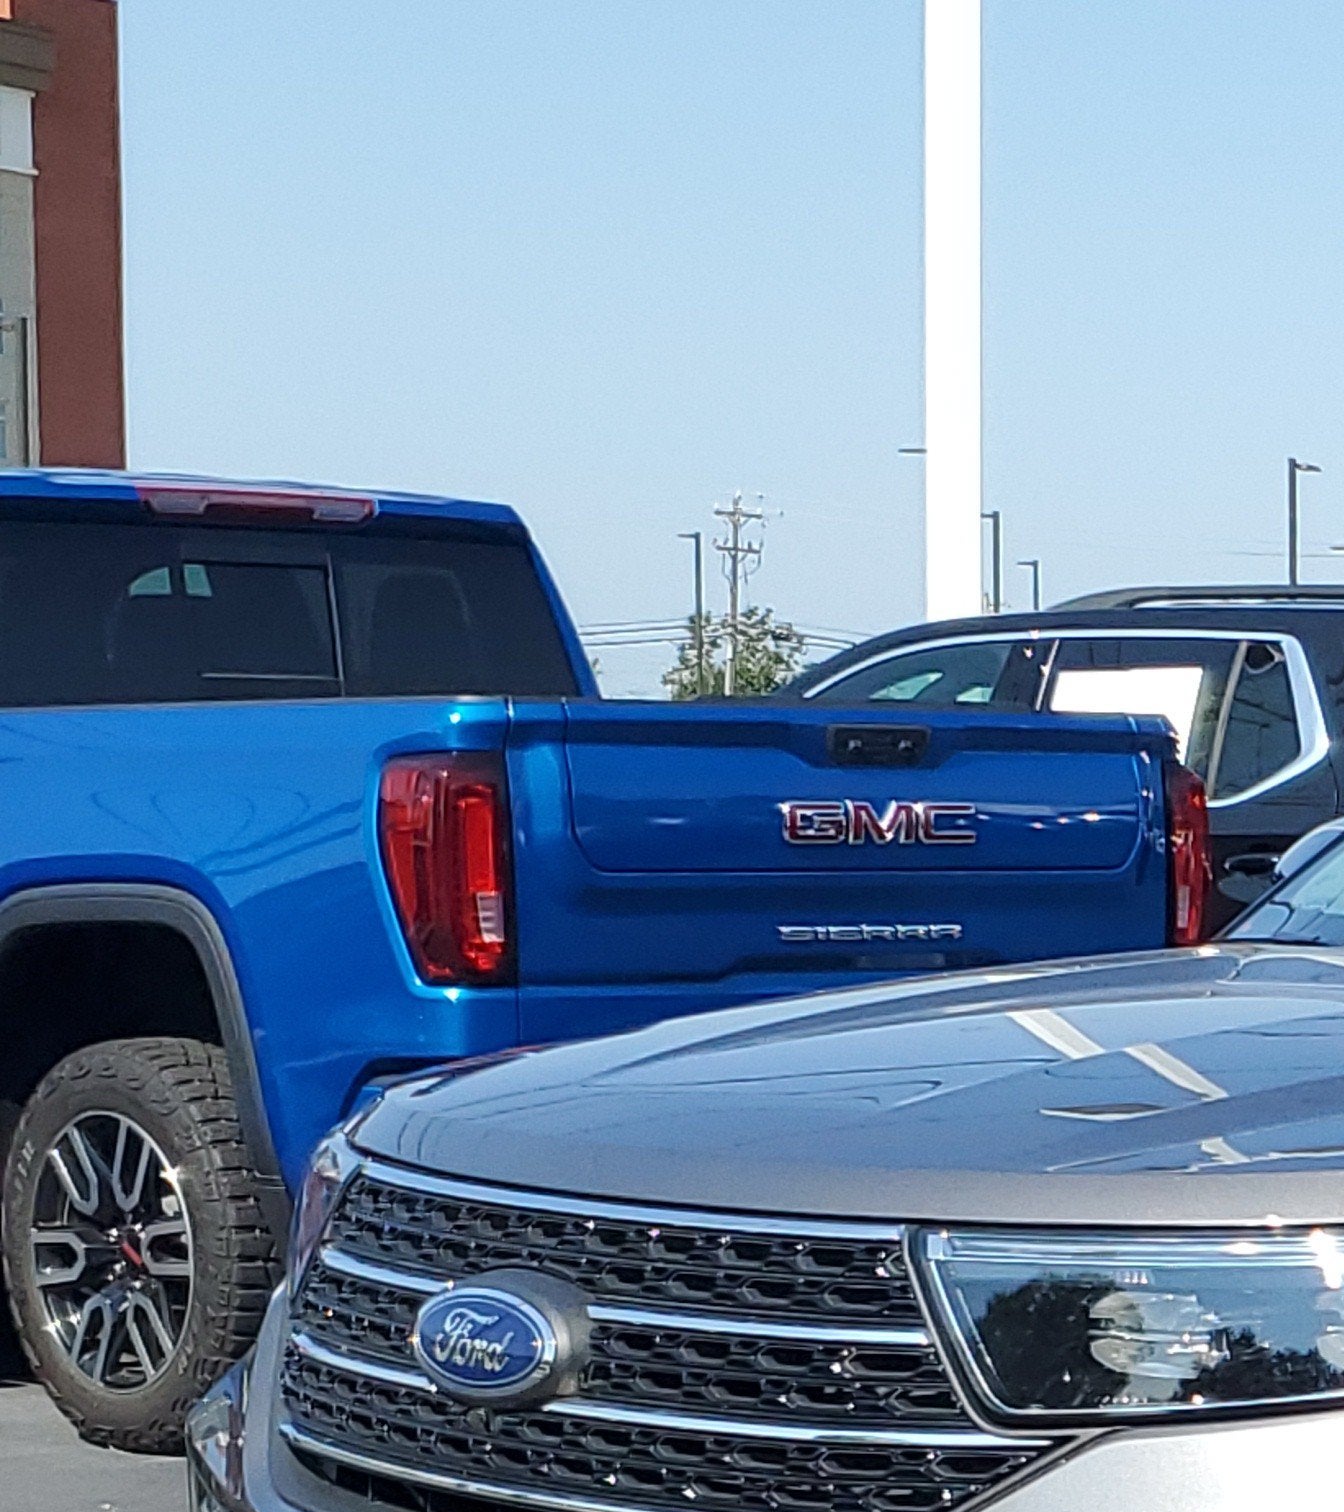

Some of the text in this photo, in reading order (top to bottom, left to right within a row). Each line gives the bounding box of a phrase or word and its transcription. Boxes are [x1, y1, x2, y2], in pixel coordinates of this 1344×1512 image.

[779, 799, 977, 846] GMC
[776, 923, 963, 941] SIERRA
[433, 1306, 515, 1373] Ford
